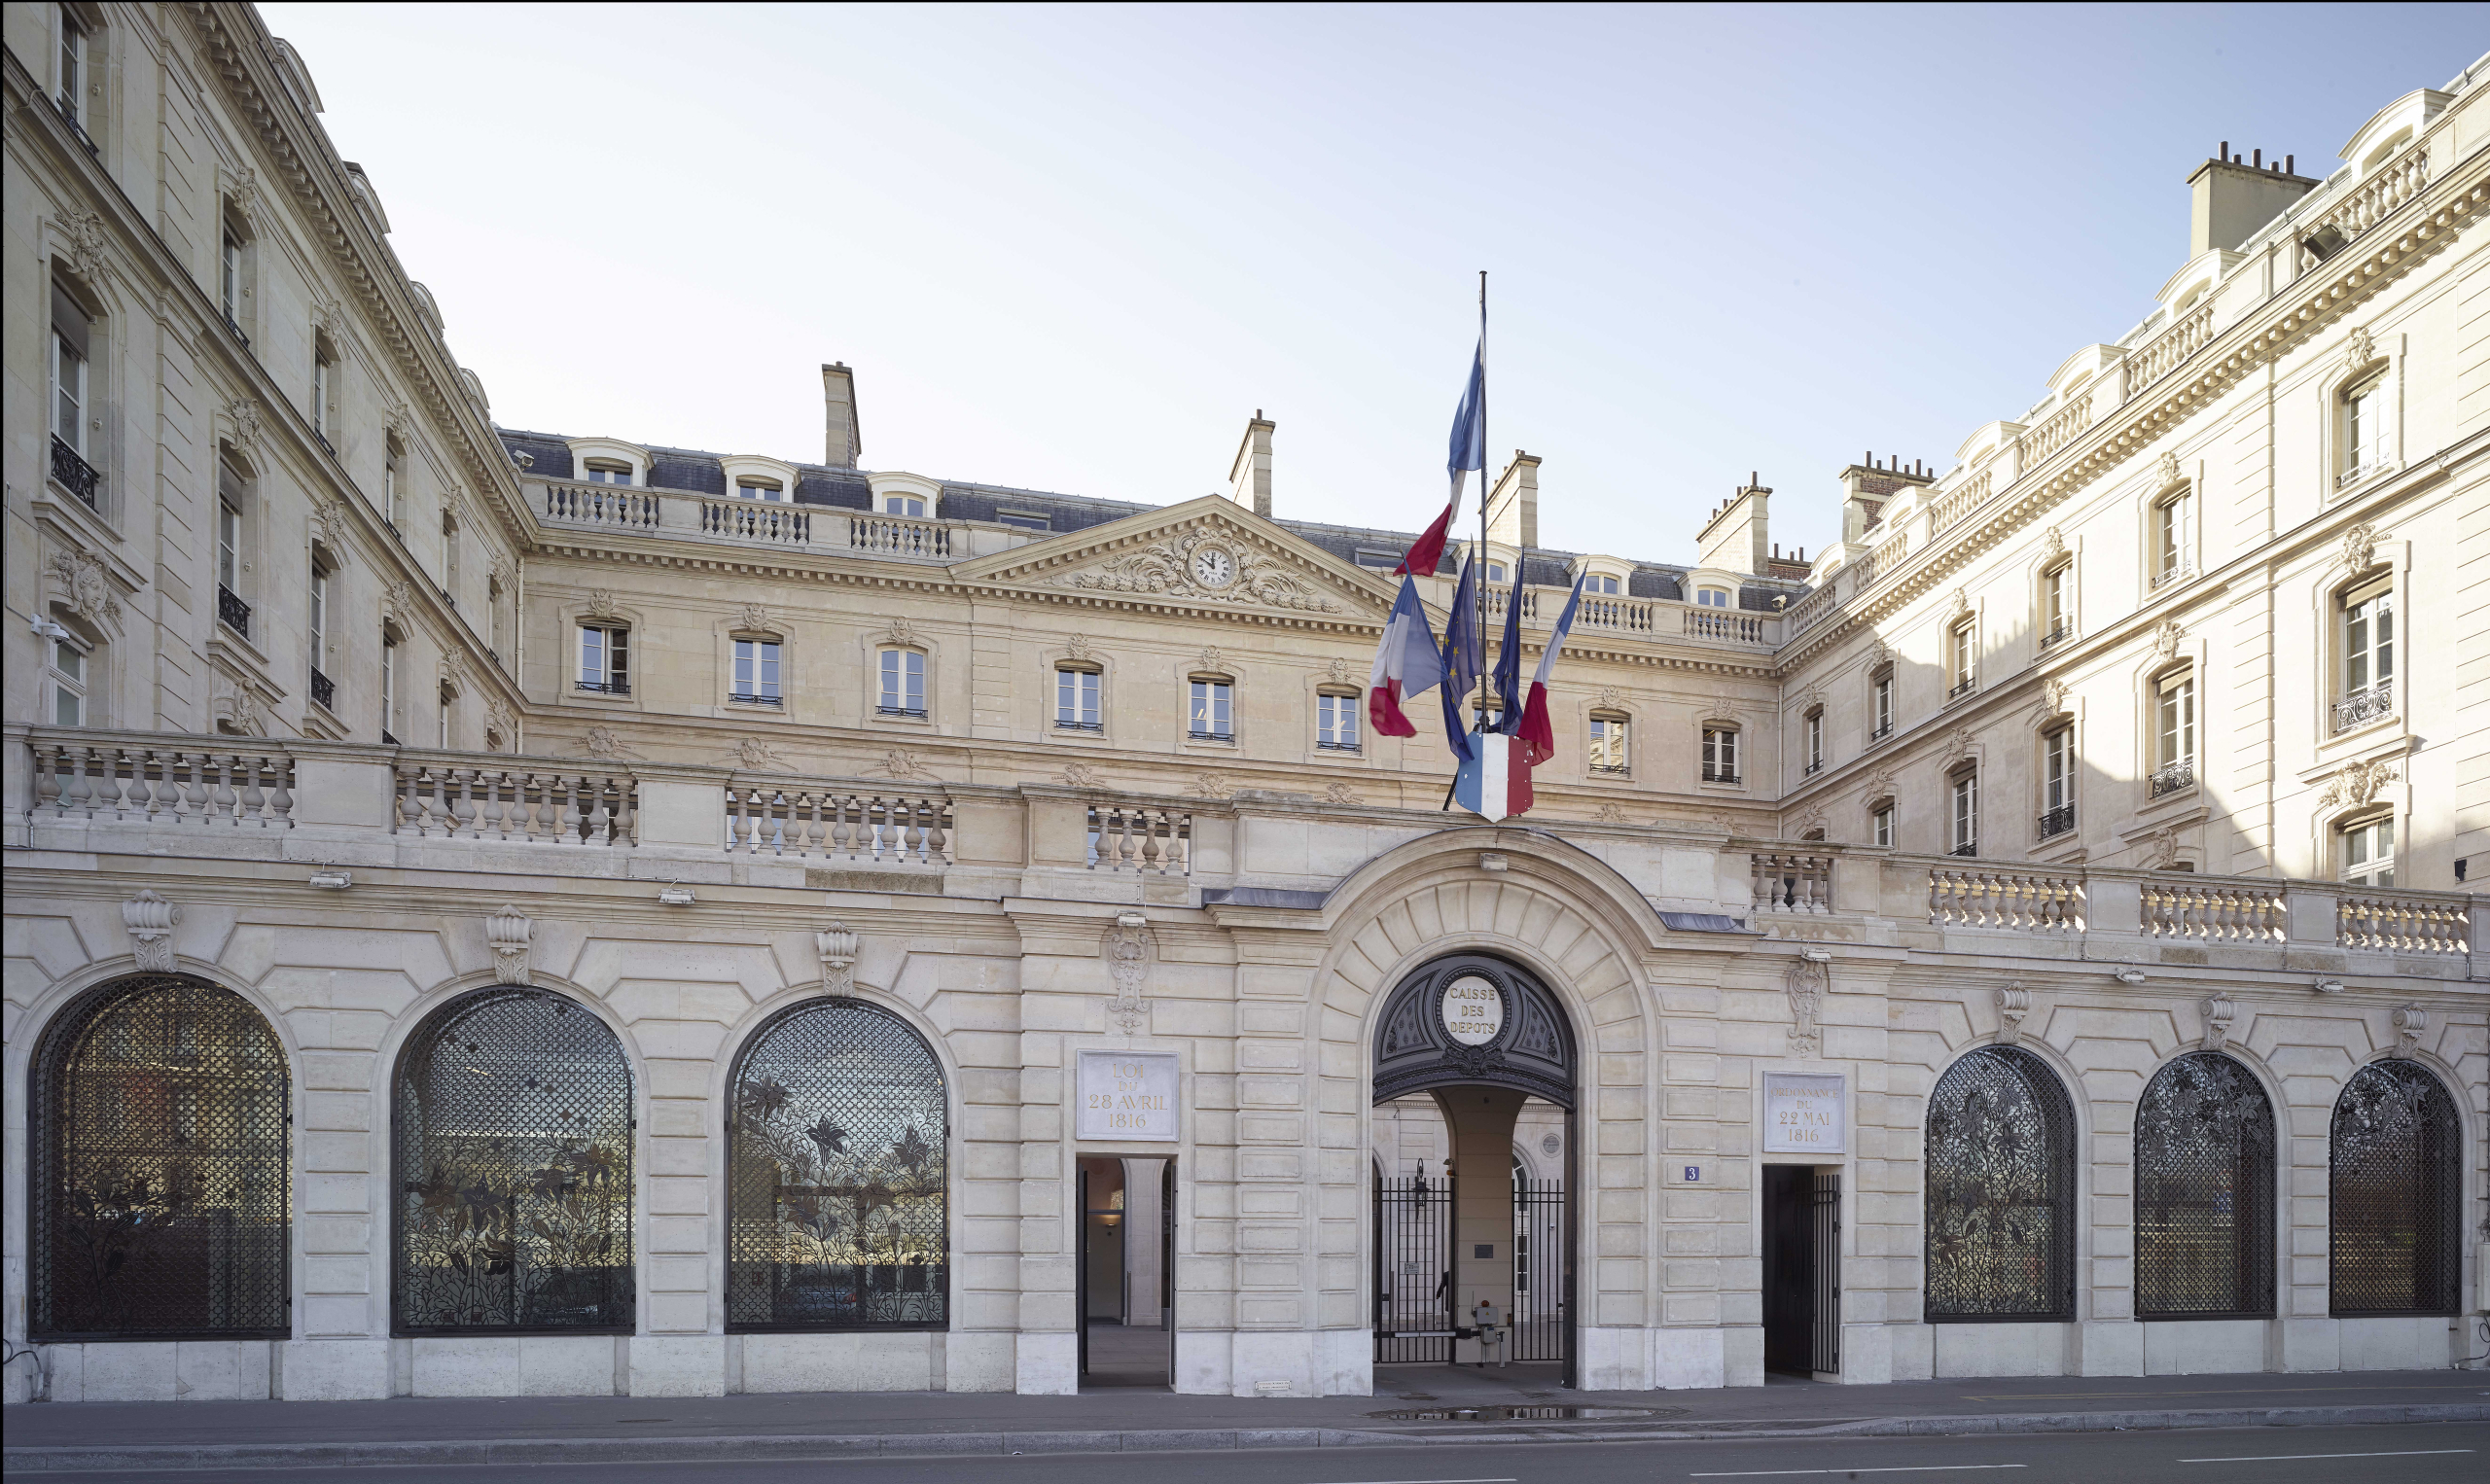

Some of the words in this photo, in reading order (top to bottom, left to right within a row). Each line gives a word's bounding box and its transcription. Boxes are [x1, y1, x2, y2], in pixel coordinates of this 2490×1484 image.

[1450, 988, 1495, 1000] CAISSE
[1461, 1005, 1484, 1017] DES
[1450, 1022, 1495, 1034] DEPOTS
[1113, 1063, 1143, 1078] LOI
[1119, 1081, 1138, 1092] DU
[1771, 1087, 1838, 1098] ORDONNANCE
[1089, 1094, 1112, 1109] 28
[1117, 1095, 1168, 1110] AVRIL
[1796, 1100, 1812, 1109] DU
[1110, 1113, 1146, 1128] 1816
[1779, 1111, 1798, 1125] 22
[1803, 1112, 1829, 1126] MAI
[1789, 1129, 1818, 1142] 1816
[1689, 1167, 1696, 1180] 3
